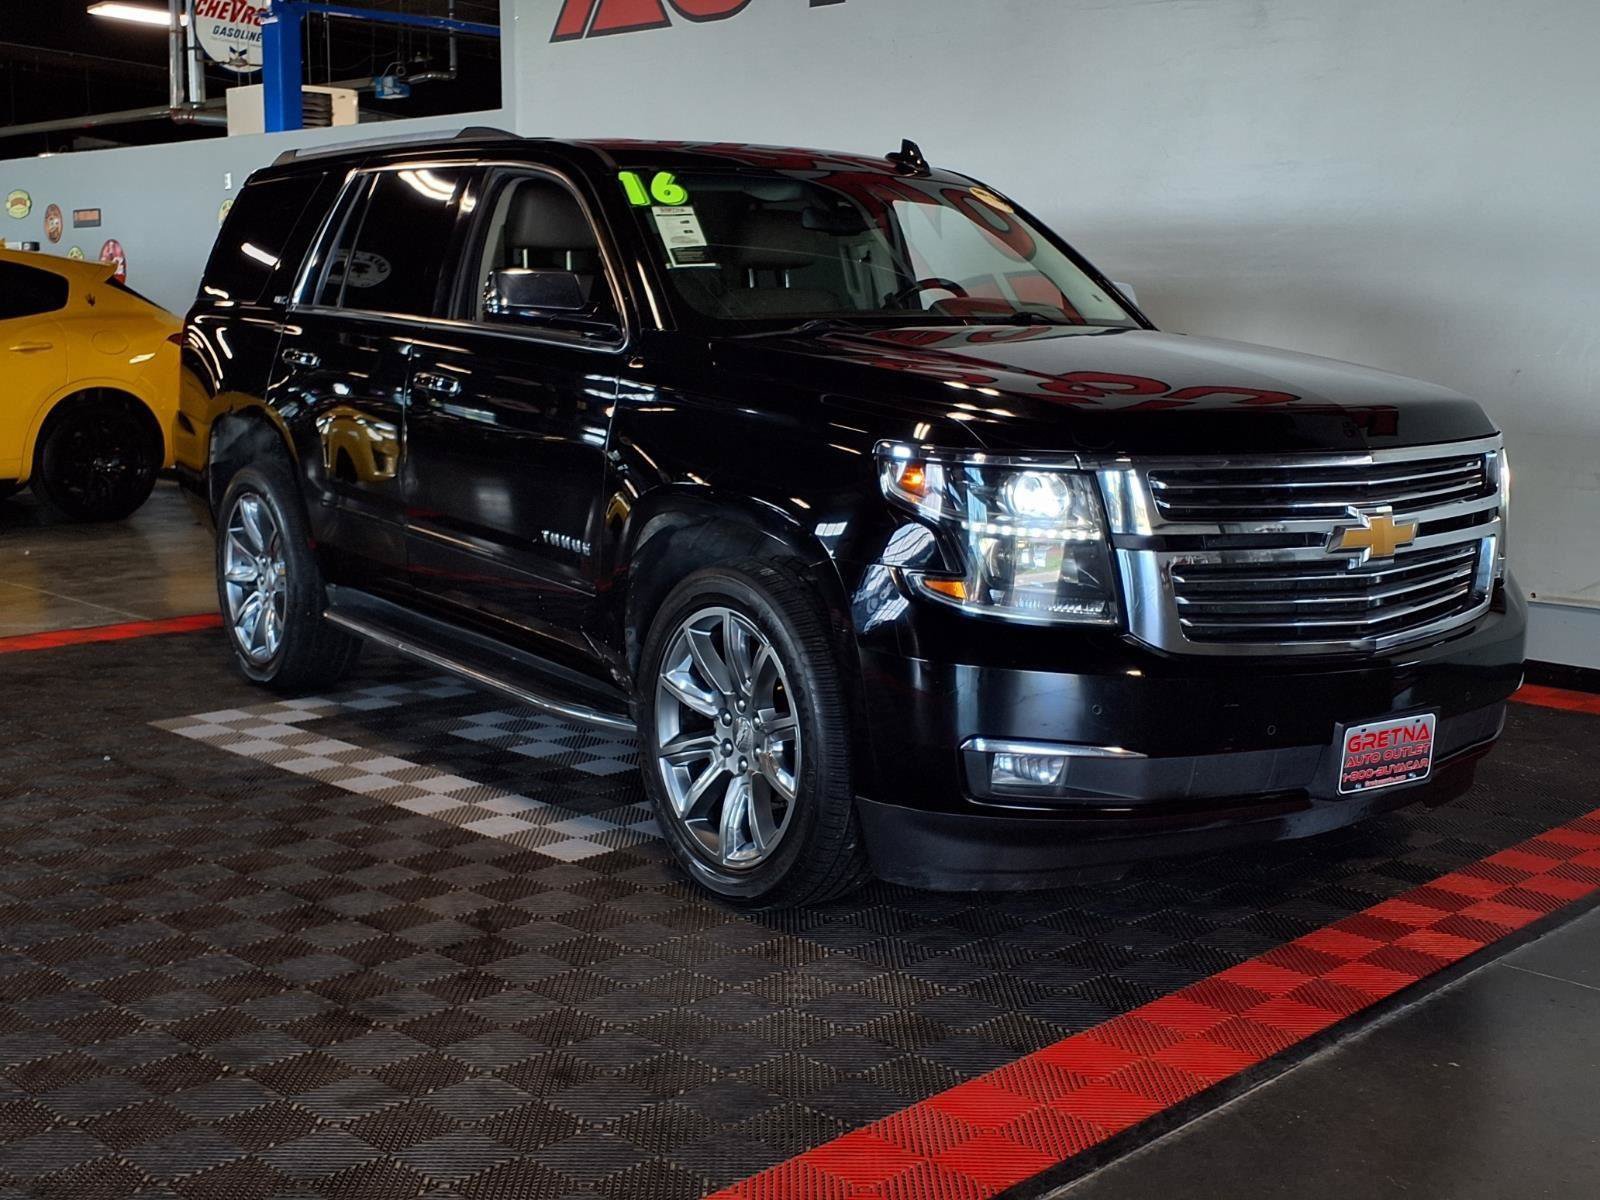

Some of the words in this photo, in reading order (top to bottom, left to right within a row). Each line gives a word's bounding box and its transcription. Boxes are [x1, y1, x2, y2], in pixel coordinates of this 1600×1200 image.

[212, 25, 263, 42] GASOLINE
[618, 171, 688, 206] 16
[1347, 723, 1430, 753] GRETNA
[1344, 751, 1380, 768] AUTO
[1383, 743, 1430, 760] OUTLET
